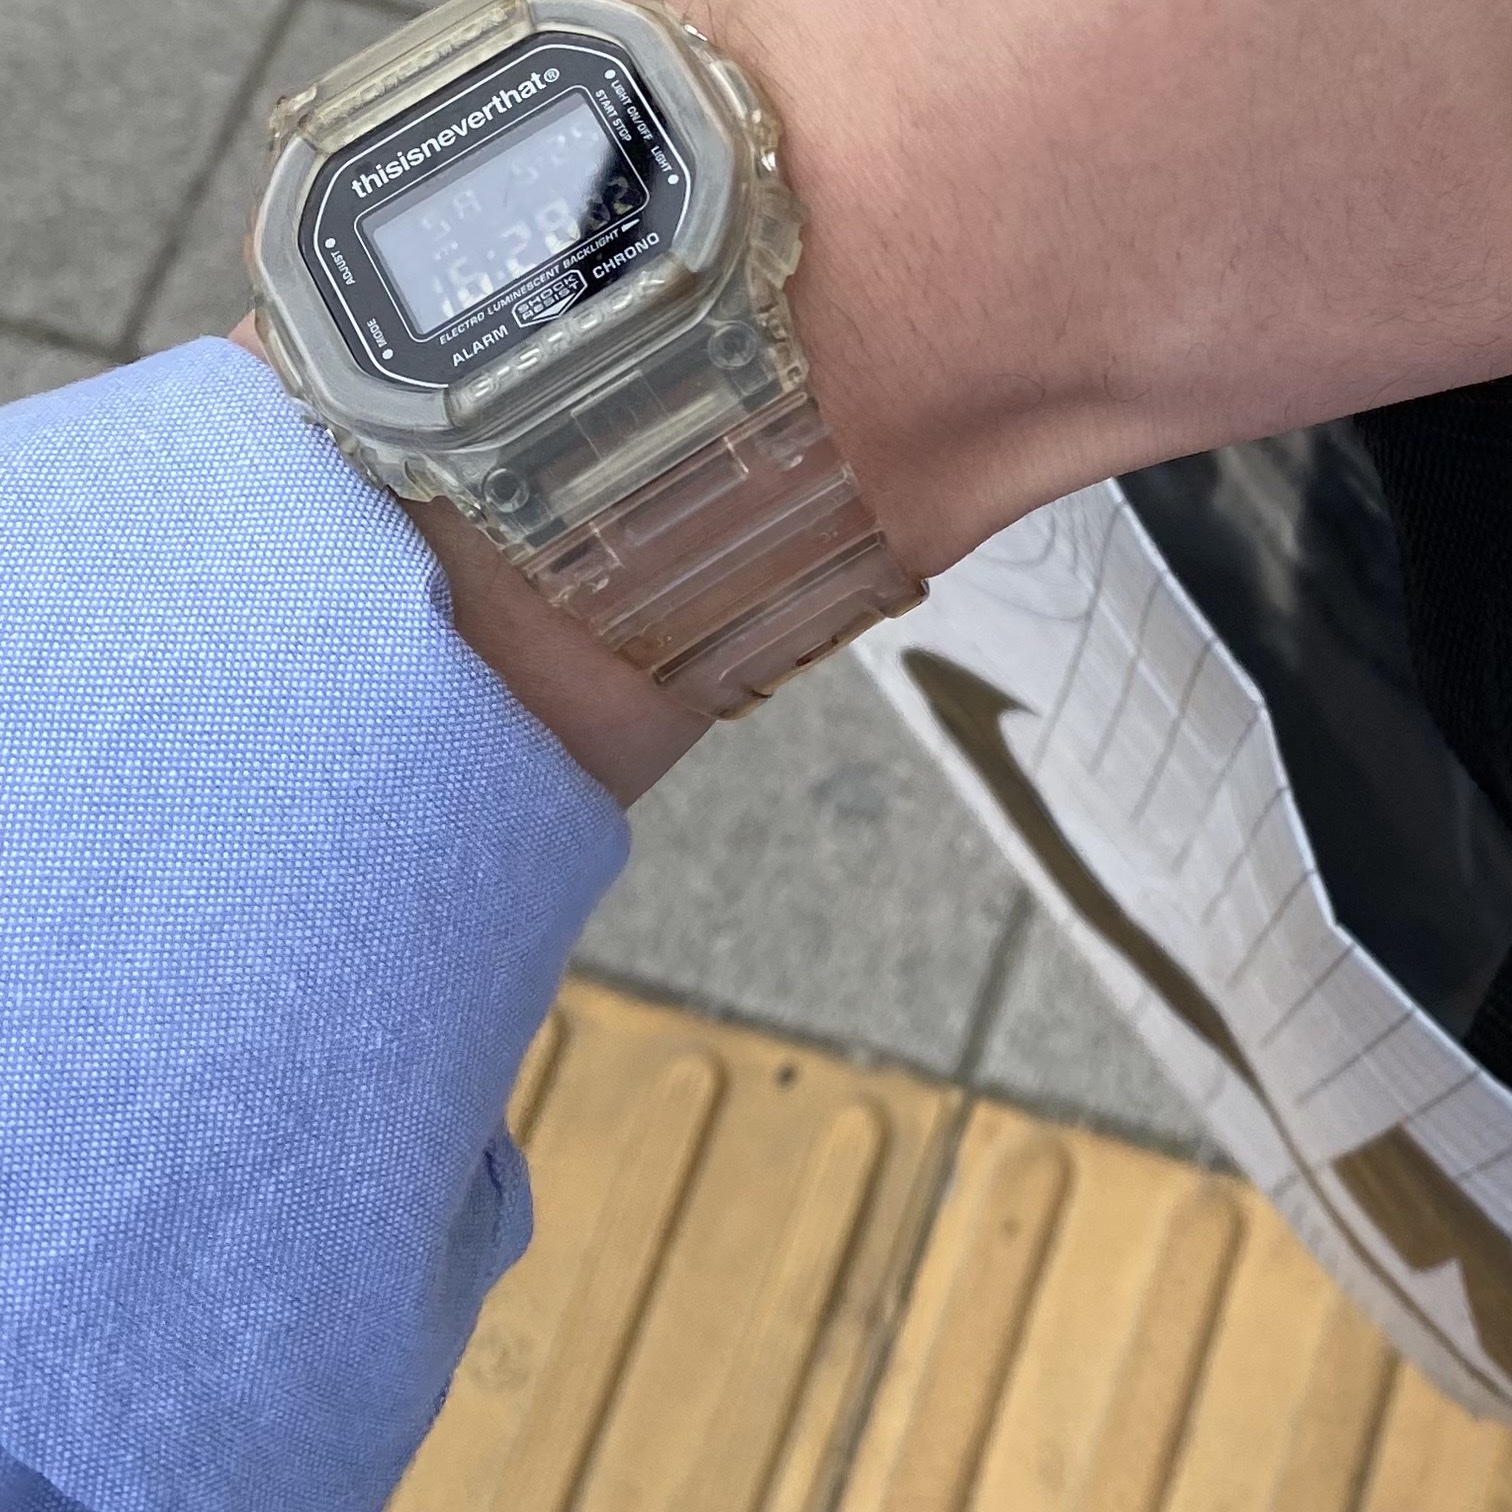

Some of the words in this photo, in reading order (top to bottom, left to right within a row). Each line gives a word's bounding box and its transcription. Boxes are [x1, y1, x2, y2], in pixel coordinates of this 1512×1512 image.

[595, 89, 618, 118] START
[612, 118, 632, 142] STOP
[611, 79, 632, 106] LIGHT
[627, 106, 653, 141] ON/OFF
[650, 145, 673, 173] LIGHT
[329, 249, 355, 286] ADJUST
[591, 232, 660, 279] CHRONO
[438, 311, 486, 345] ELECTRO
[487, 266, 561, 316] LUMINESCENT
[562, 229, 620, 269] BACKLIGHT
[517, 274, 578, 314] SHOCK
[521, 282, 581, 321] RESIST
[366, 317, 388, 349] MODE
[452, 324, 510, 367] ALARM
